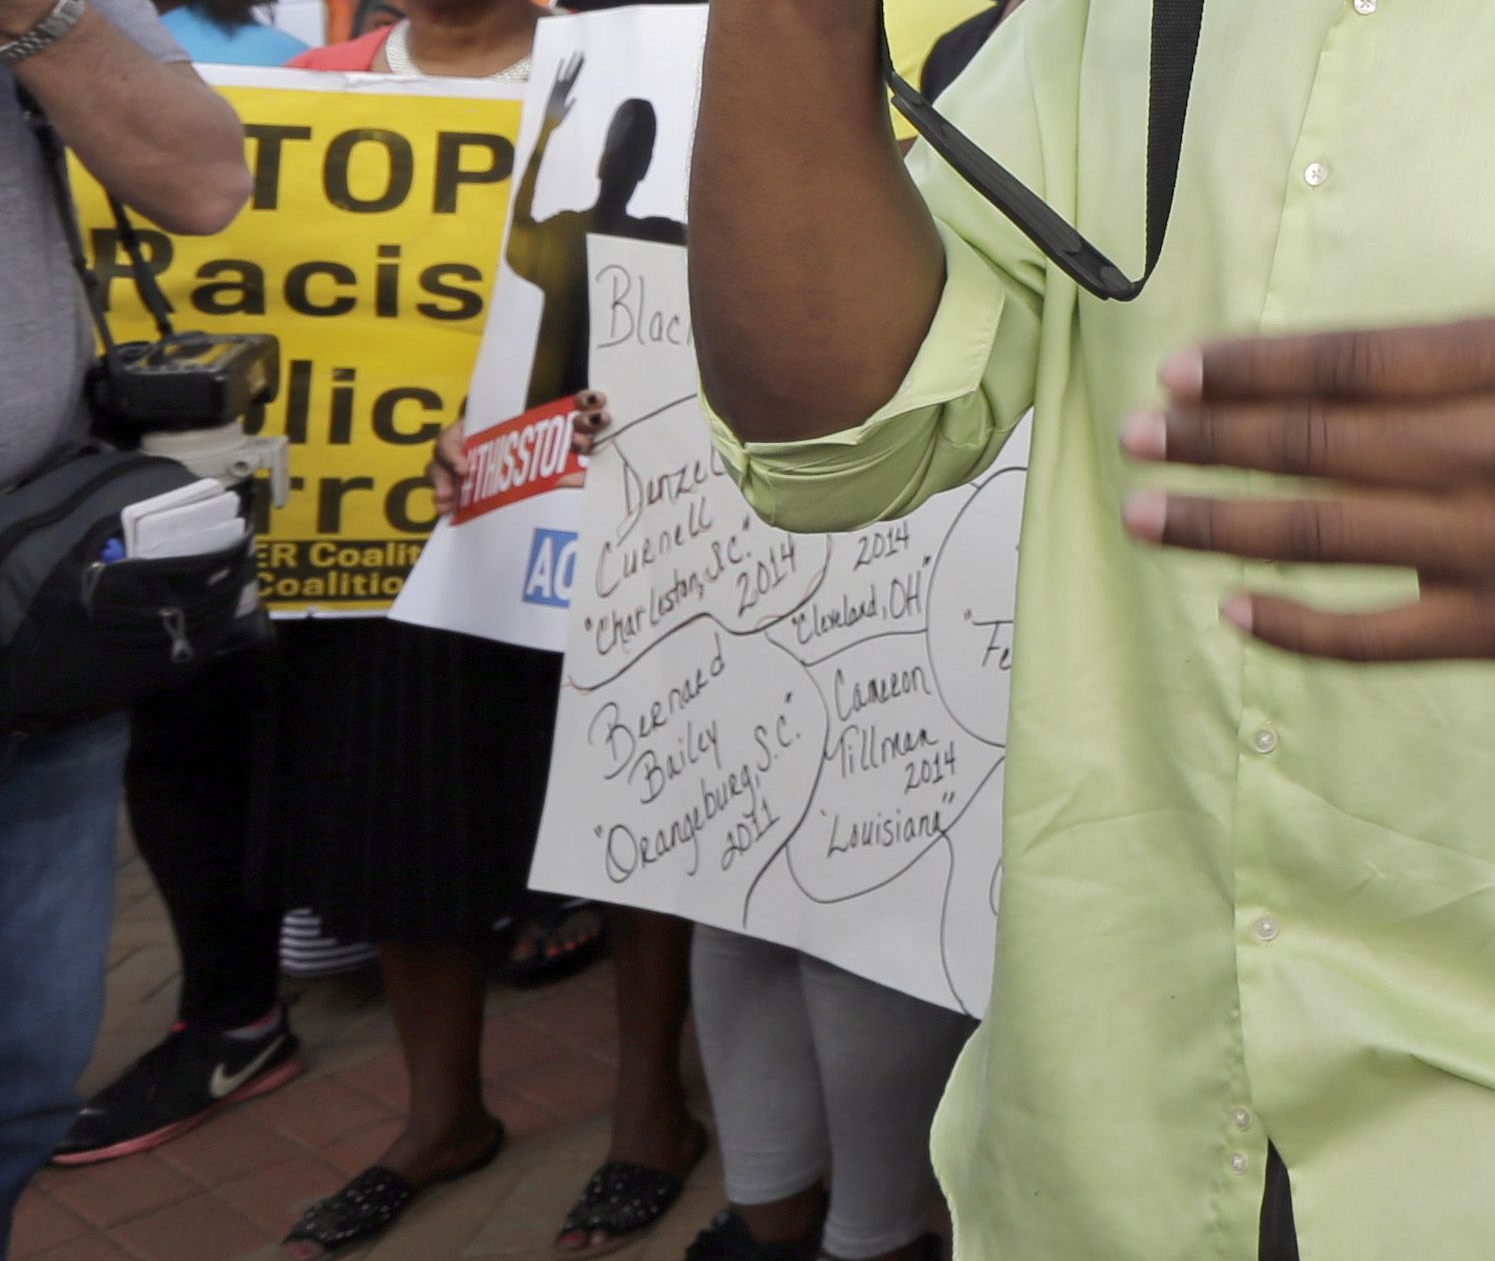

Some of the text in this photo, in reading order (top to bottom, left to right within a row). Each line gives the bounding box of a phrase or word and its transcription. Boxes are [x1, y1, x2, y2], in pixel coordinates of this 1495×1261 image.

[243, 123, 516, 216] TOP
[90, 226, 485, 322] Racis
[595, 263, 693, 350] Blac
[309, 539, 423, 569] Coalit
[737, 534, 797, 618] 2014
[853, 521, 910, 572] 2014
[256, 570, 404, 599] Coalitio
[903, 740, 956, 796] 2014
